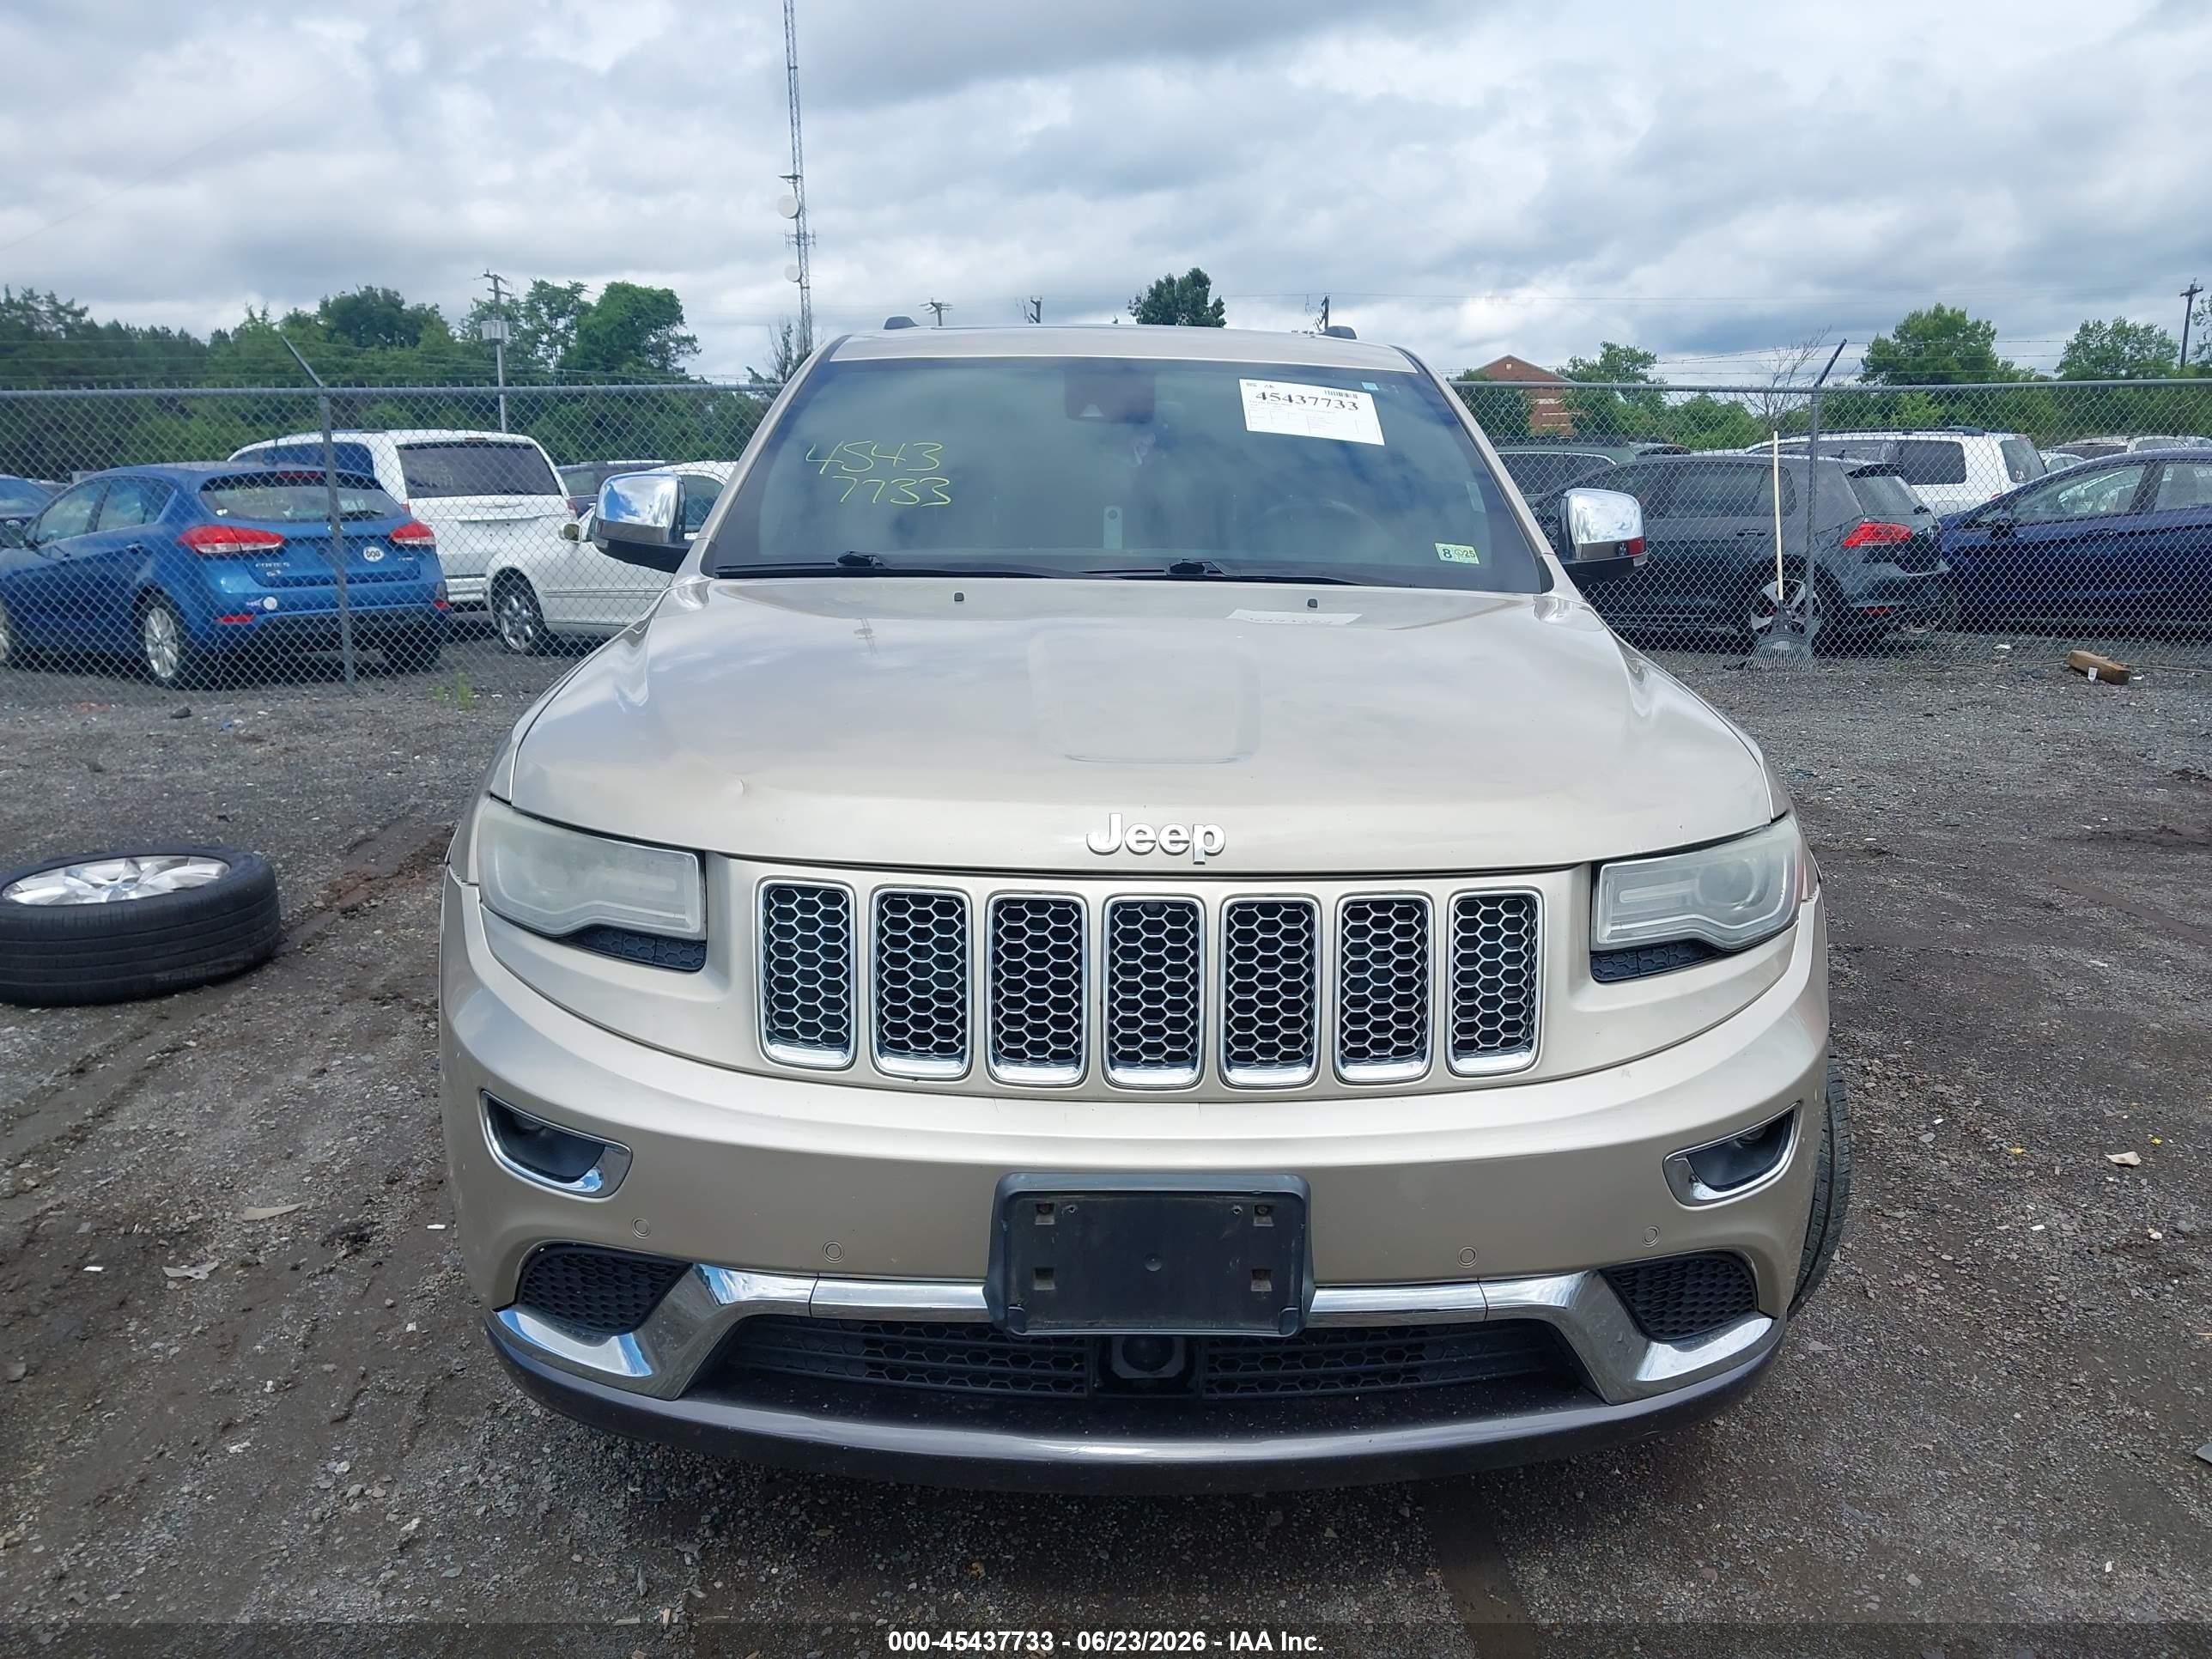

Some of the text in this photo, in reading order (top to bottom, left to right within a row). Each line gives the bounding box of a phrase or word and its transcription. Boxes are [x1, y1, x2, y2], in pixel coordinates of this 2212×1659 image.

[1255, 391, 1359, 412] 45437733
[805, 440, 944, 475] 4543
[830, 476, 952, 507] 7733
[1443, 548, 1453, 559] 8
[1085, 812, 1226, 866] Jeep
